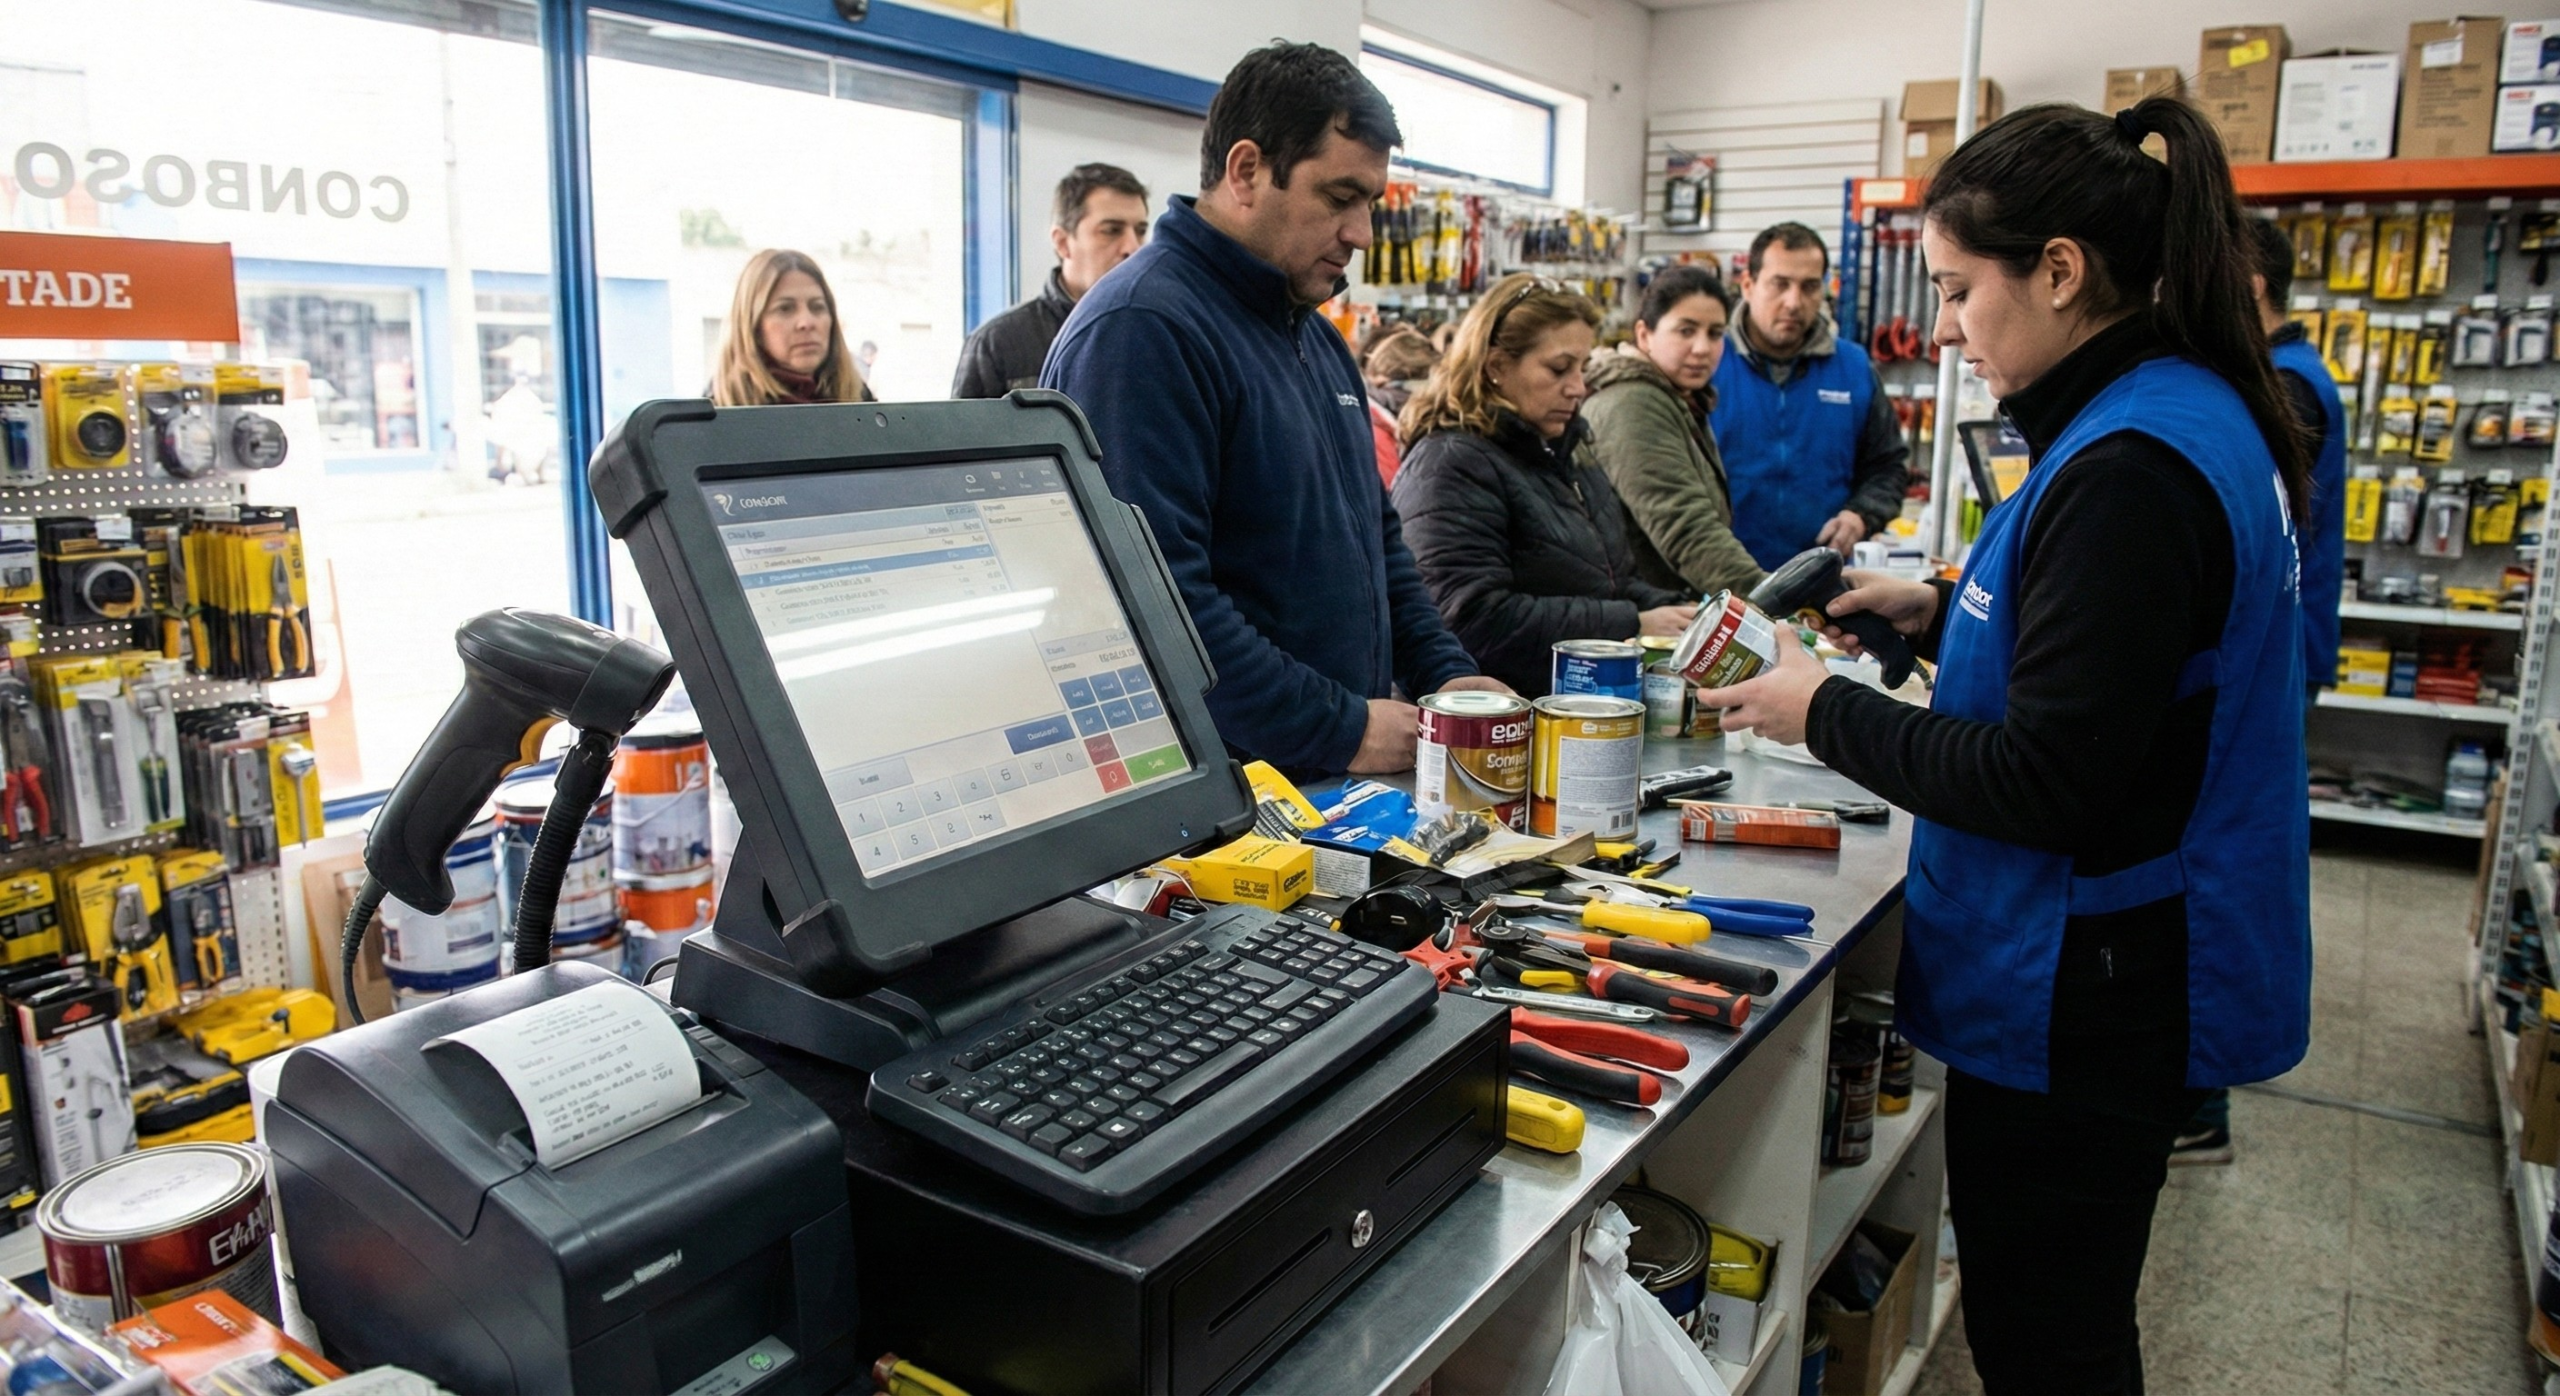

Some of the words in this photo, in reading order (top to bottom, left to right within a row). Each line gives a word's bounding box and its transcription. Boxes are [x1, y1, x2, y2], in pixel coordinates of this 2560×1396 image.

[934, 791, 942, 801] 3
[896, 802, 905, 813] 2
[858, 812, 866, 823] 1
[910, 834, 919, 845] 5
[873, 846, 881, 857] 4
